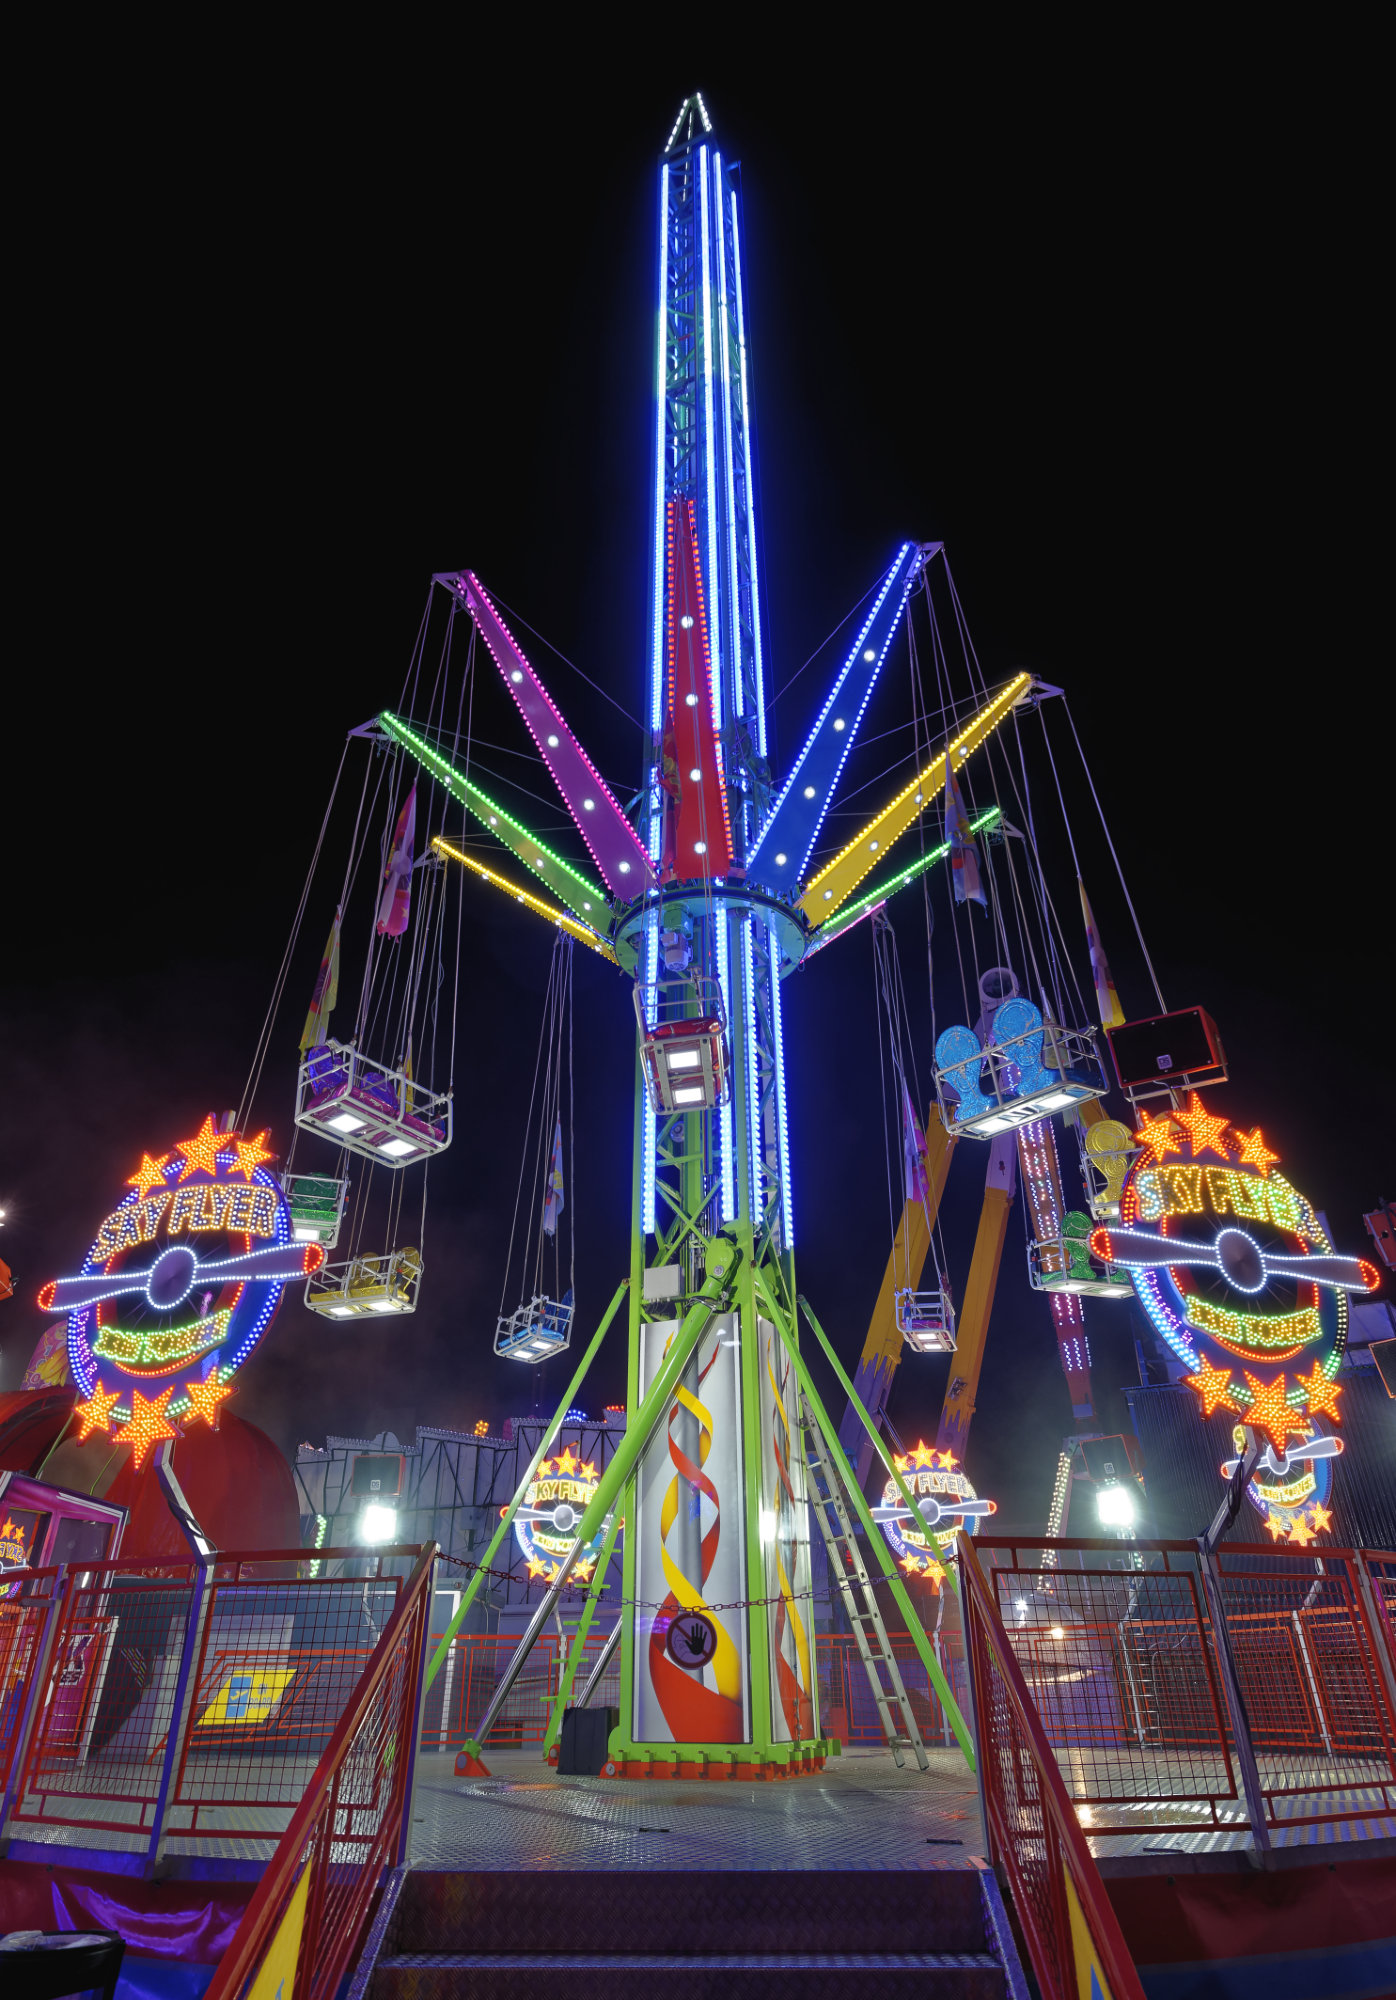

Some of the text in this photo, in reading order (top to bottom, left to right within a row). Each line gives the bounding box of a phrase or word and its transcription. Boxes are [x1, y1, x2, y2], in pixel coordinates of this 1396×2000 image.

[91, 1182, 279, 1264] SKY FLYER
[1135, 1163, 1324, 1247] SKY FLYER
[1240, 1306, 1324, 1348] TOWER
[523, 1478, 598, 1506] SKY FLYE
[884, 1471, 972, 1504] SY FLYER
